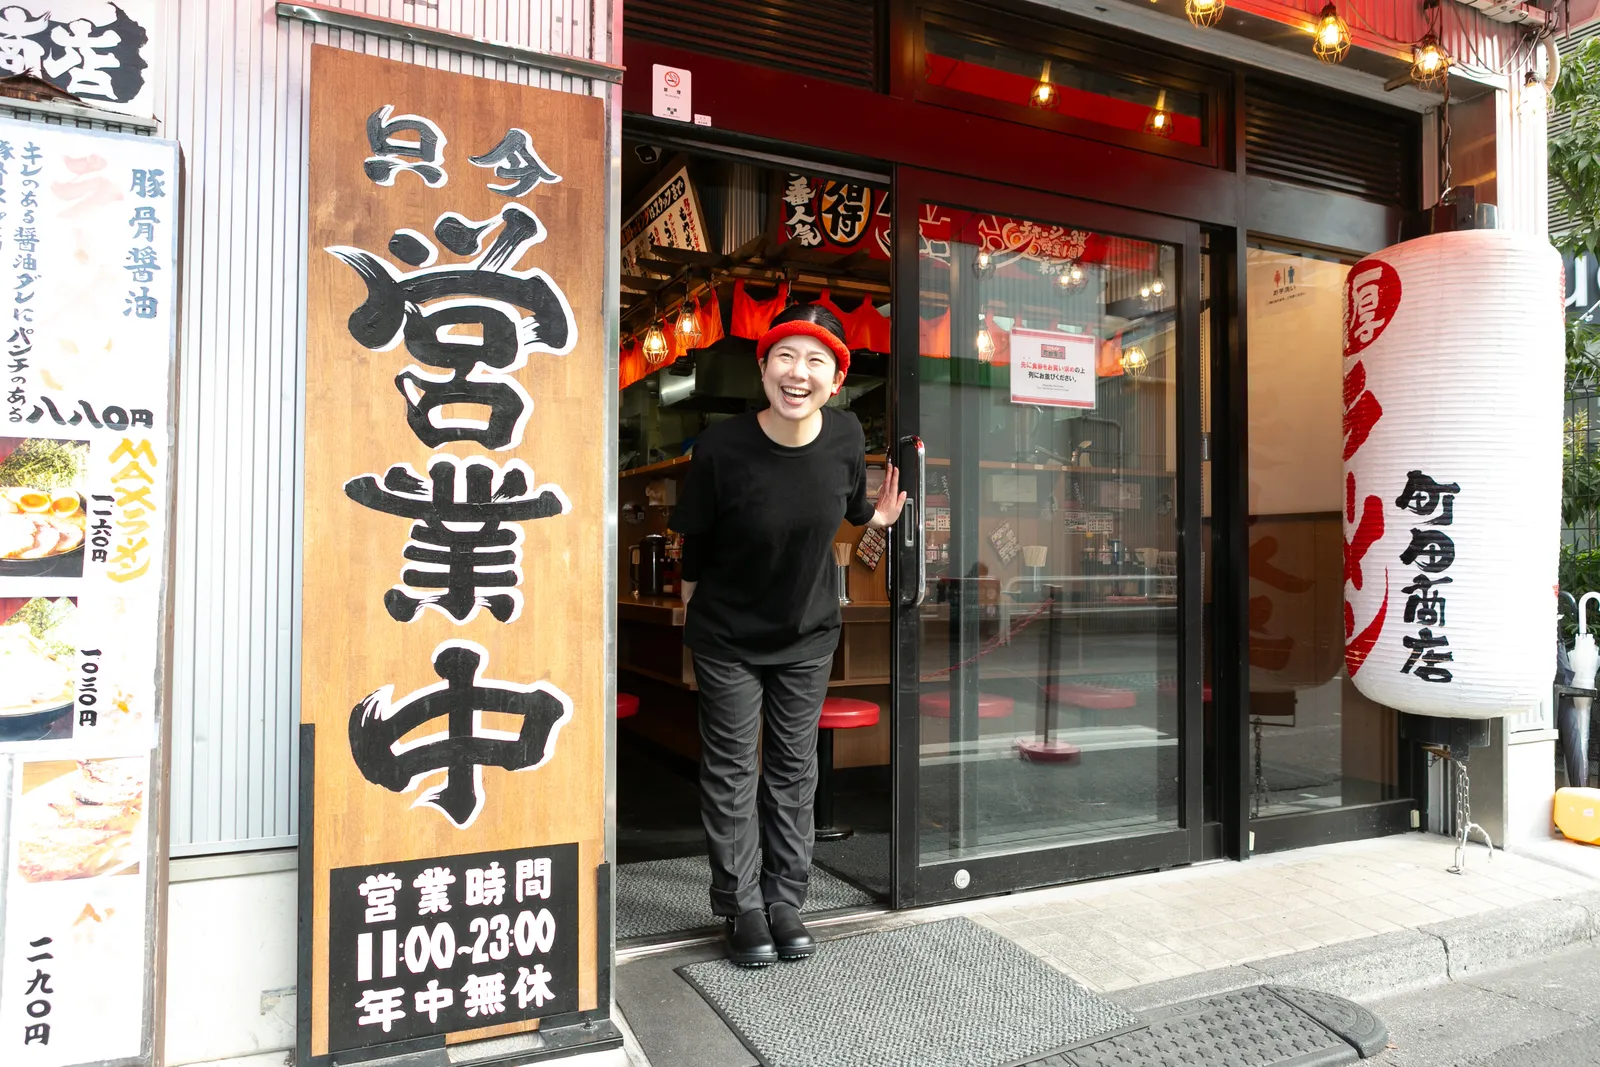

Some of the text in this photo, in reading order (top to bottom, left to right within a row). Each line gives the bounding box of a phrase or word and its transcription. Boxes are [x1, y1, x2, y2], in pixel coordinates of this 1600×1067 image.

[6, 141, 43, 423] キレのある醤油ダレにパンチのある
[123, 168, 166, 320] 豚骨醤油
[324, 201, 578, 831] 営業中
[1395, 470, 1461, 684] 町田商店
[358, 857, 552, 924] 営業時間
[354, 963, 556, 1033] 年中無休
